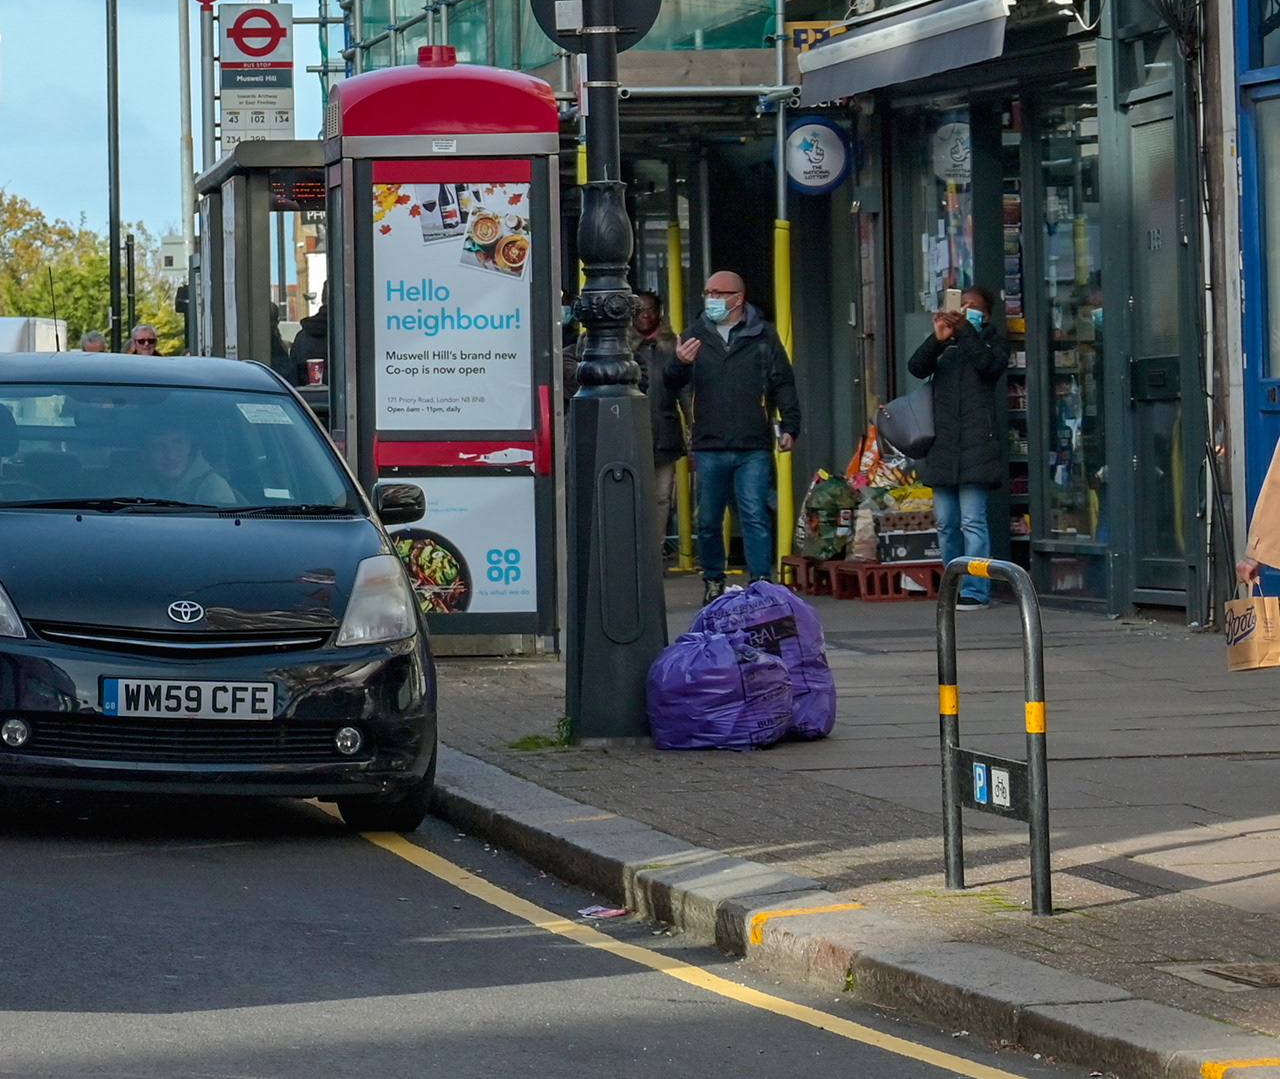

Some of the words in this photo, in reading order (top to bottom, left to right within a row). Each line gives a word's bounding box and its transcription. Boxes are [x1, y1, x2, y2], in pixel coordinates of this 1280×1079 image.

[229, 115, 239, 123] 43
[250, 115, 265, 123] 102
[275, 115, 289, 123] 134
[386, 278, 450, 302] Hello
[386, 307, 521, 337] neighbour!
[386, 351, 430, 361] Muswell
[432, 351, 458, 360] Hill's
[460, 351, 491, 360] brand
[386, 365, 419, 376] Co-op
[422, 365, 430, 374] is
[458, 367, 486, 376] open
[124, 684, 202, 713] WM59
[211, 686, 269, 714] CFE
[105, 702, 116, 710] GB
